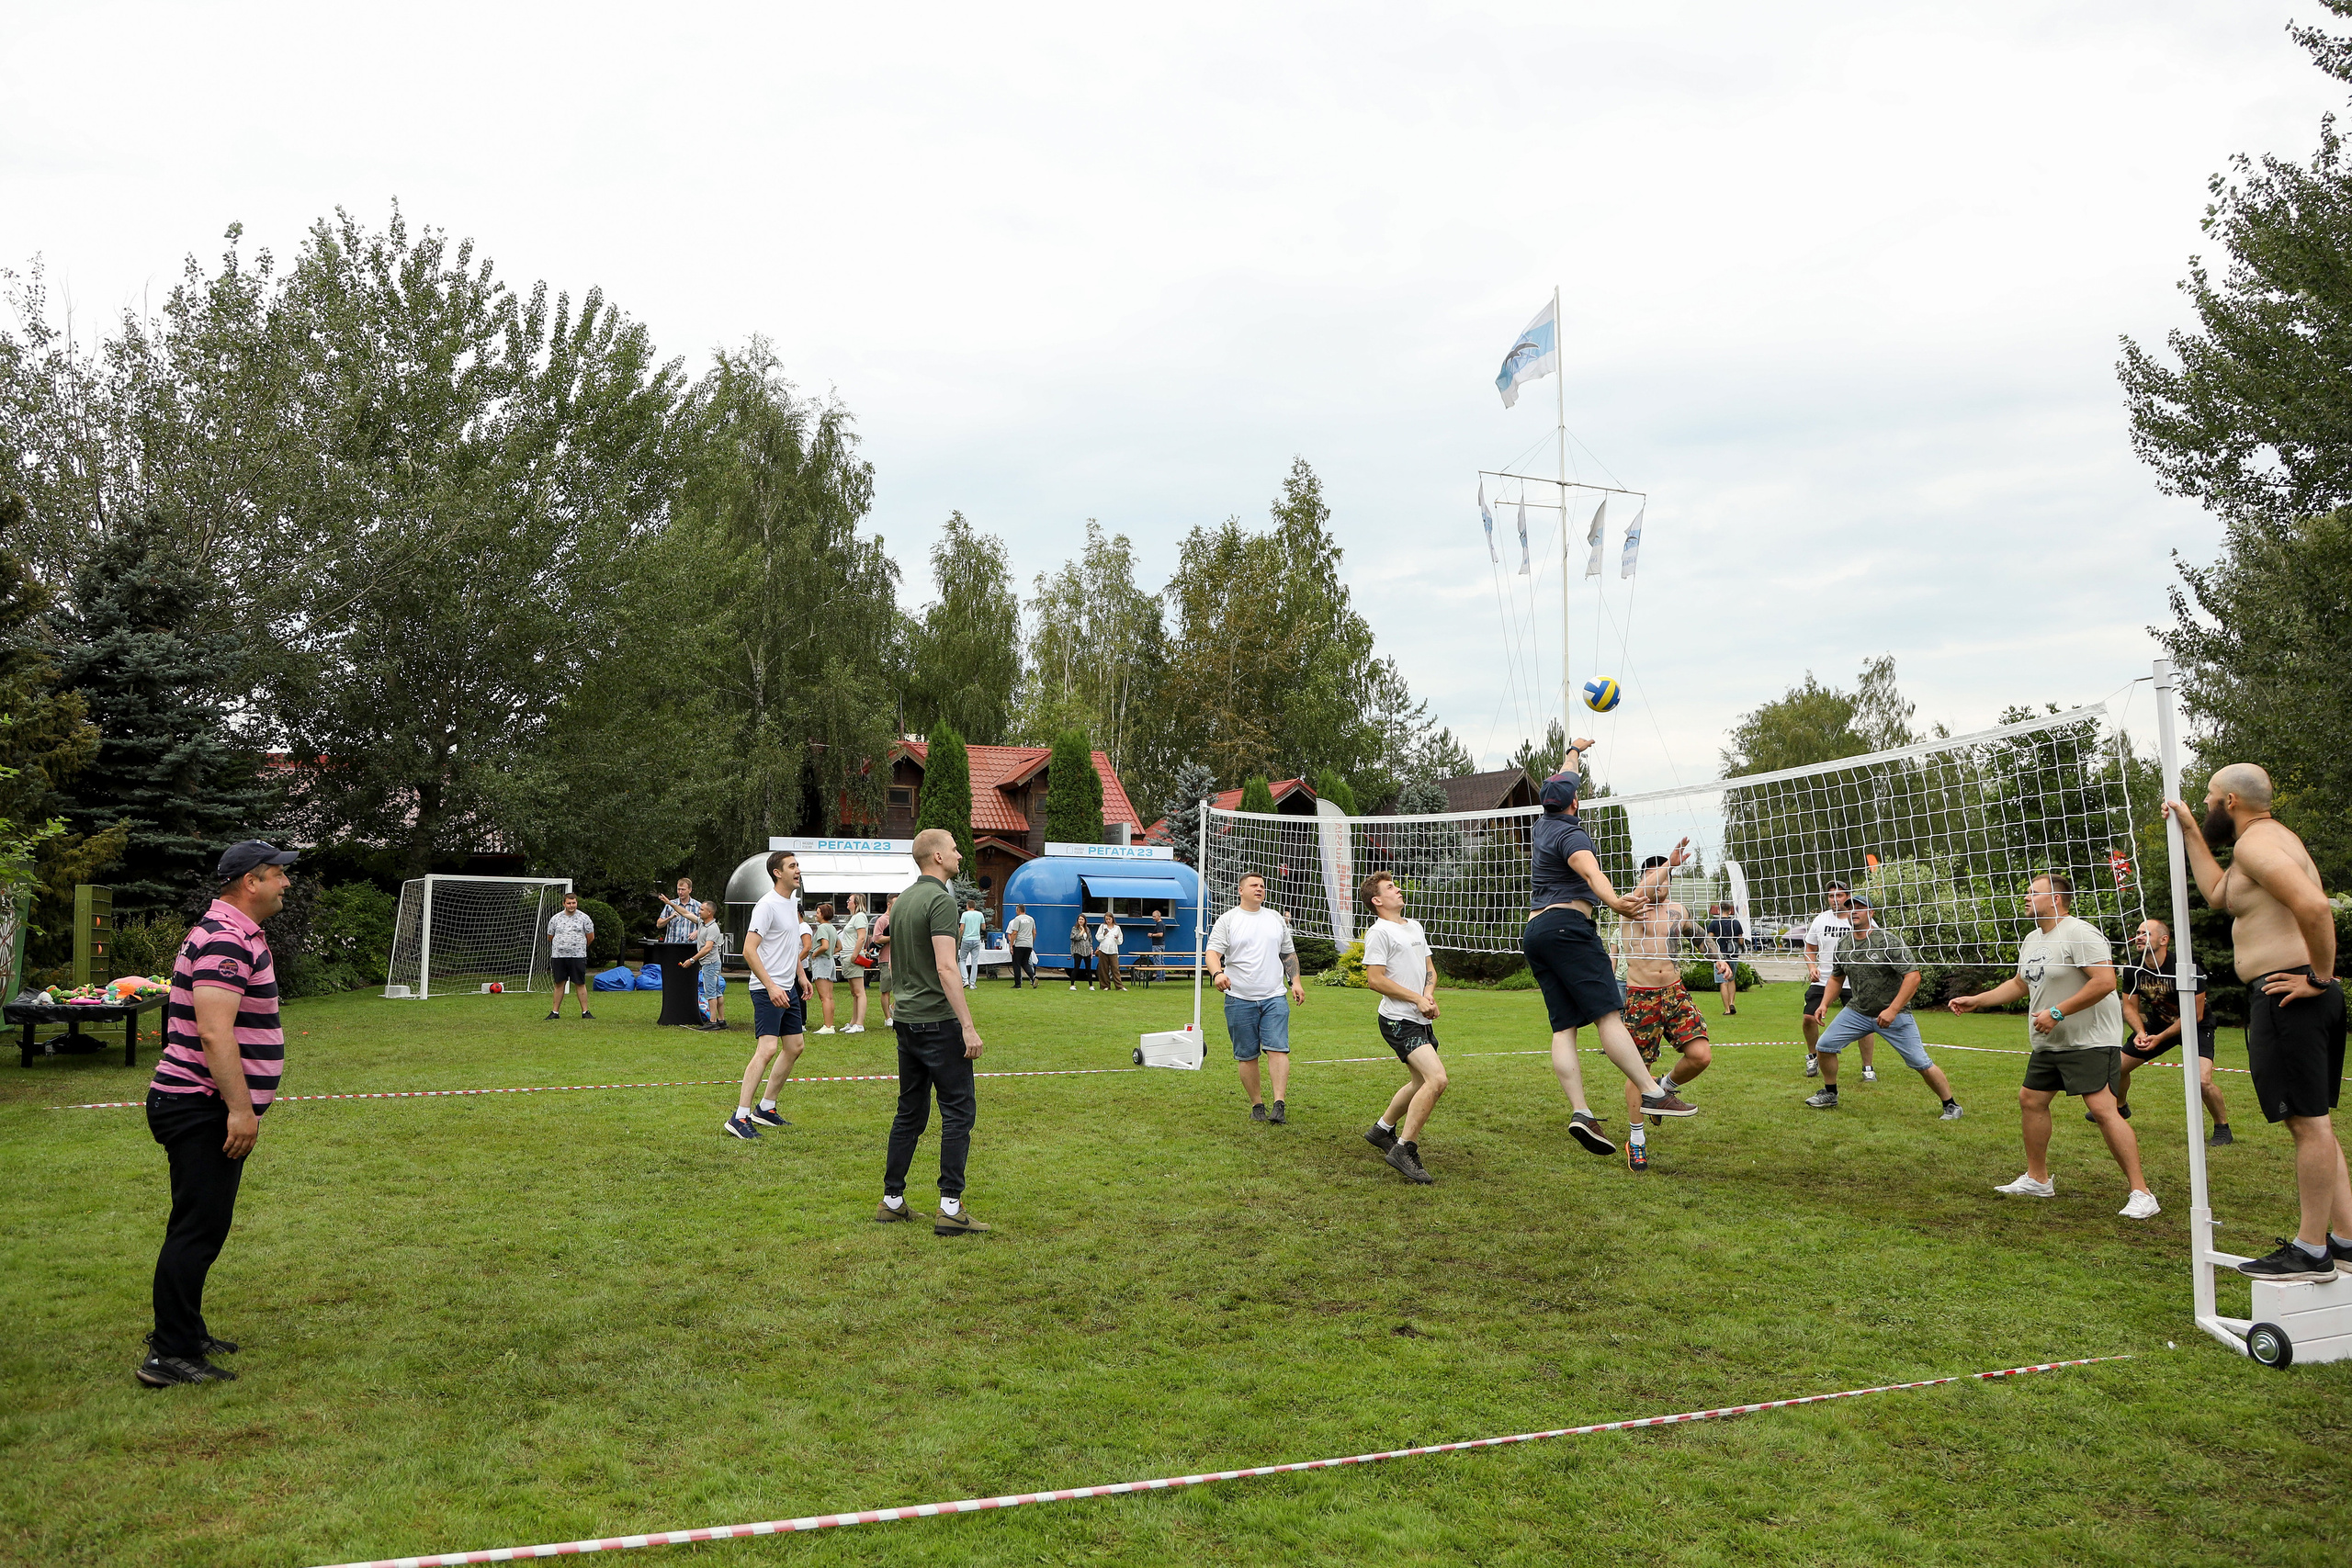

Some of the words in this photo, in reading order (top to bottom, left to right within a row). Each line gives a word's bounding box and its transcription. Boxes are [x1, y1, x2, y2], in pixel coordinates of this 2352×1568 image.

[818, 840, 891, 851] РЕГАТА'23
[1088, 846, 1153, 857] РЕГАТА'23
[1824, 925, 1852, 938] PUM
